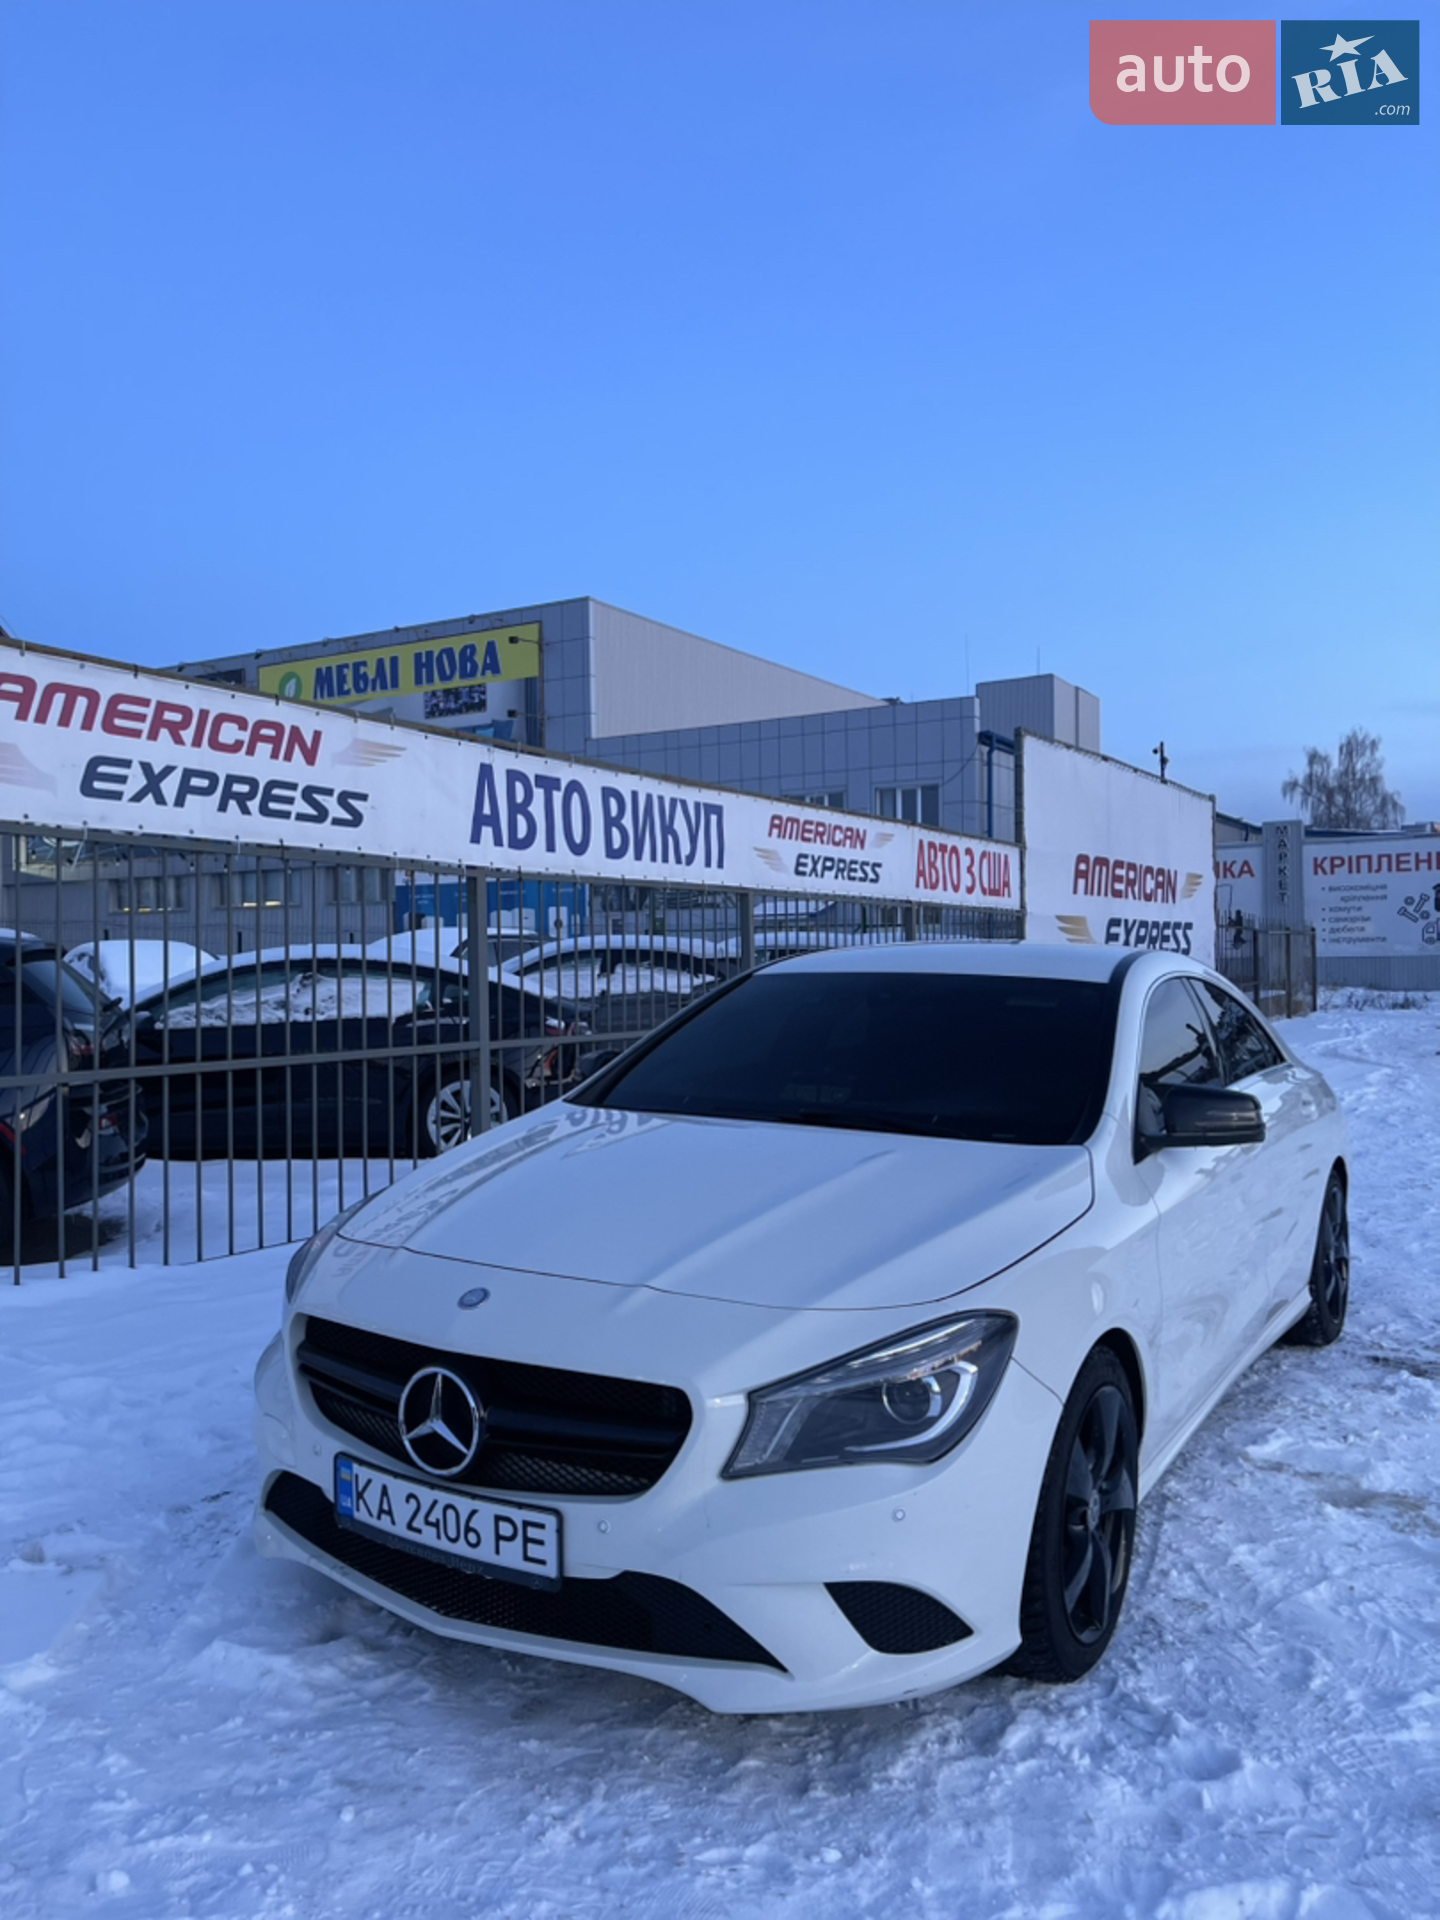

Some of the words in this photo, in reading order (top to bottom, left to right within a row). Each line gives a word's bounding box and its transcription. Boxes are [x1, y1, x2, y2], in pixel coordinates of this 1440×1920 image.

[313, 655, 399, 700] МЕБЛІ
[413, 640, 501, 687] НОВА
[0, 672, 322, 767] AMERICAN
[79, 755, 370, 828] EXPRESS
[469, 762, 592, 856] АВТО
[601, 786, 724, 870] ВИКУП
[767, 814, 867, 850] AMERICAN
[794, 853, 883, 884] EXPRESS
[915, 838, 961, 894] АВТО
[979, 850, 1012, 898] США
[1072, 853, 1178, 904] AMERICAN
[1275, 826, 1288, 902] МАРКЕТ
[1312, 851, 1440, 876] КРІПЛЕН
[1104, 917, 1193, 956] EXPRESS
[354, 1473, 397, 1526] KA
[404, 1492, 482, 1549] 2406
[493, 1513, 548, 1566] PE
